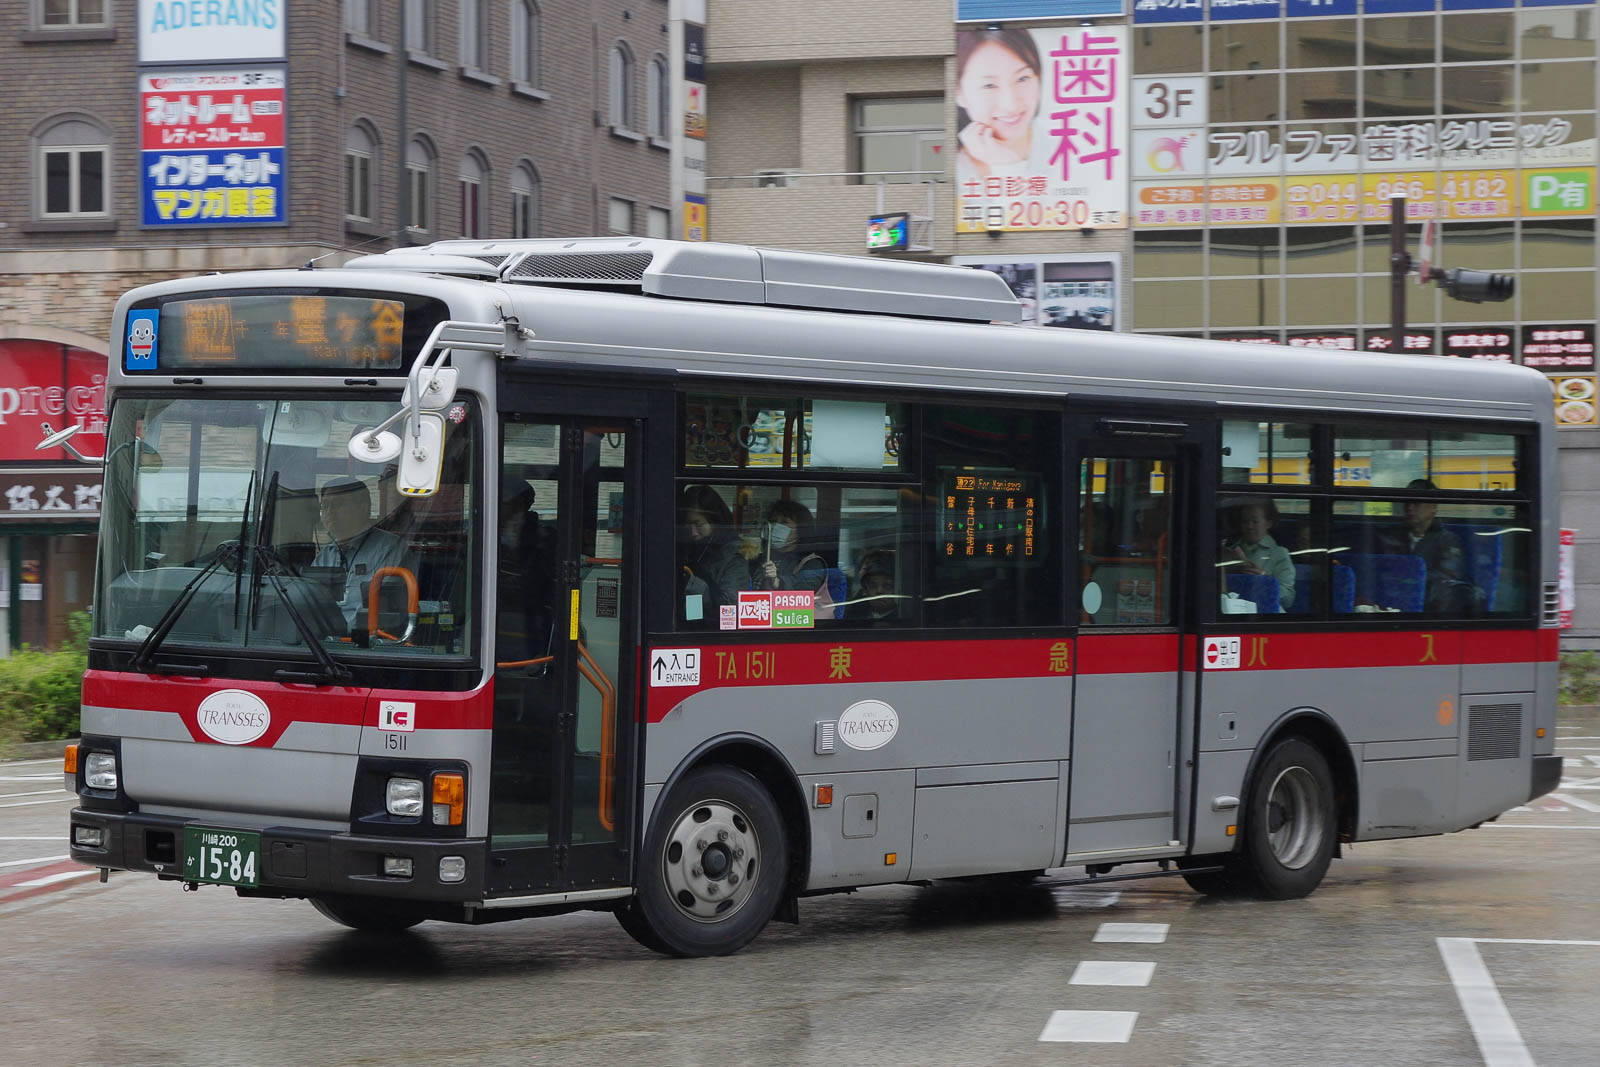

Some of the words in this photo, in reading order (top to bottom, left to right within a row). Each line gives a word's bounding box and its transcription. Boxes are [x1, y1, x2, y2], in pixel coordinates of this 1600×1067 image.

[152, 0, 277, 33] ADERANS
[146, 95, 252, 125] ネットルーム
[1049, 32, 1120, 181] 歯科
[1146, 83, 1194, 119] 3F
[1208, 118, 1572, 165] アルファ歯科クリニック
[150, 153, 279, 186] インターネット
[963, 176, 1048, 198] 土日診療
[1310, 178, 1507, 203] 044-866-4182
[1531, 176, 1588, 209] P有
[154, 187, 277, 219] マンガ喫茶
[741, 599, 770, 621] バス特
[774, 595, 811, 607] PASMO
[776, 612, 809, 625] Suica
[1220, 640, 1238, 655] 出口
[670, 654, 695, 670] 入口
[715, 652, 737, 679] TA
[746, 651, 775, 679] 1511
[1221, 657, 1235, 665] EXIT
[666, 673, 698, 682] ENTRANCE
[385, 734, 407, 751] 1511
[187, 855, 195, 867] か
[200, 846, 255, 883] 15-84
